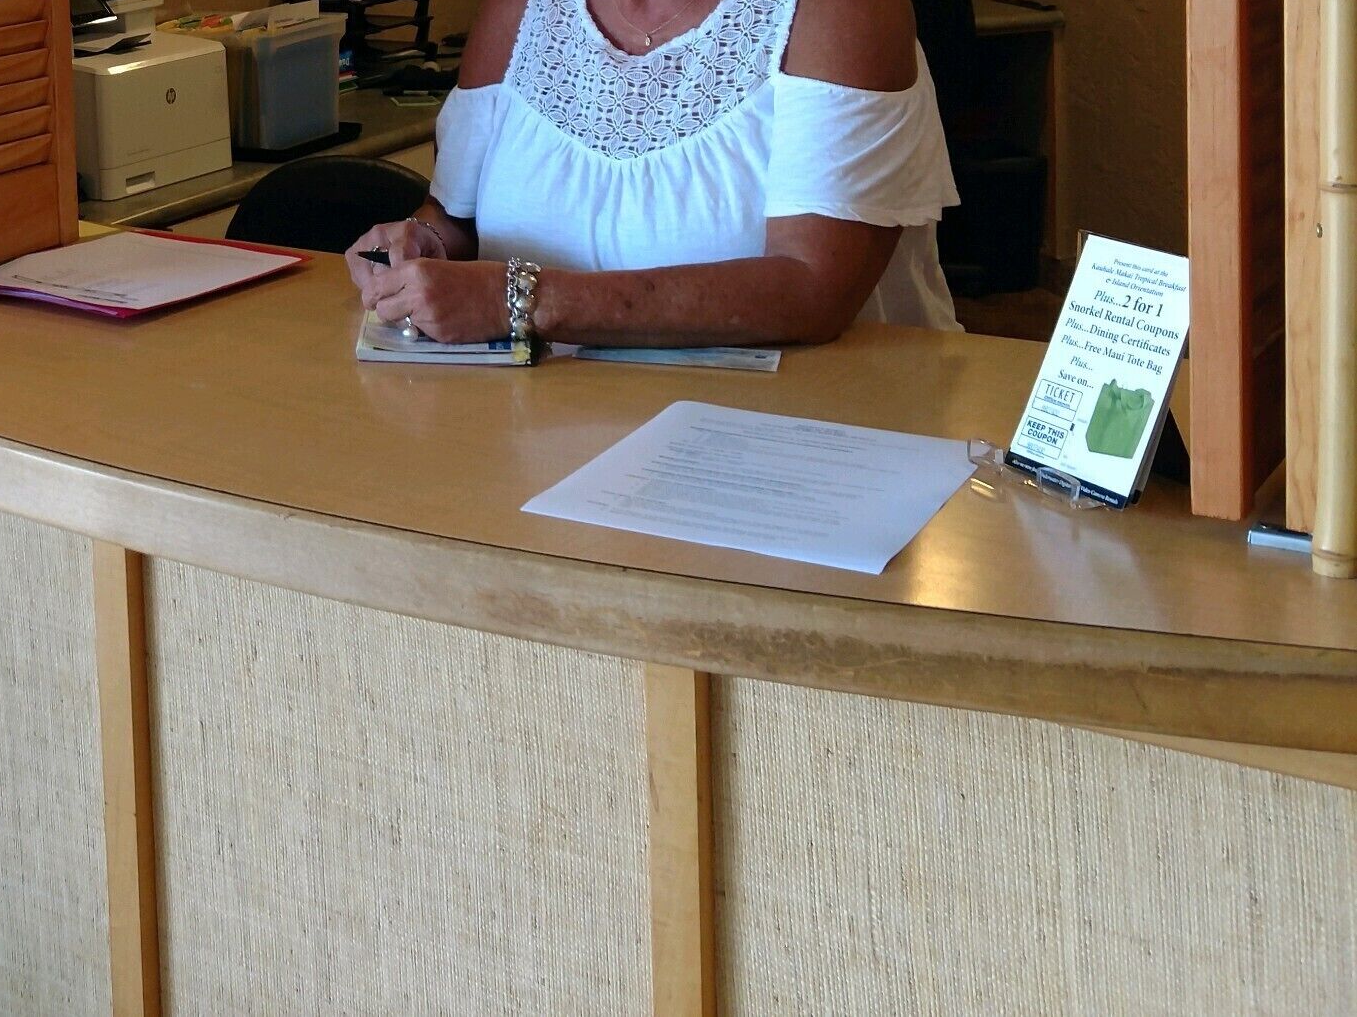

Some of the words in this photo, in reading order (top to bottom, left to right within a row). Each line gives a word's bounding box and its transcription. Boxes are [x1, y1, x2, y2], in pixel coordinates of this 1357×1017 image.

[1111, 278, 1130, 290] Island
[1130, 282, 1164, 298] Orientation
[1134, 273, 1159, 286] Tropical
[1158, 279, 1187, 293] Breakfast
[1133, 296, 1154, 315] for
[1155, 303, 1164, 318] 1
[1068, 300, 1105, 319] Snorkel
[1104, 309, 1136, 328] Rental
[1135, 319, 1180, 341] Coupons
[1120, 333, 1172, 357] Certificates
[1069, 355, 1094, 372] Plus...
[1102, 346, 1126, 362] Maui
[1126, 353, 1146, 368] Tote
[1145, 359, 1163, 376] Bag
[1057, 369, 1077, 384] Save
[1045, 383, 1076, 404] TICKET
[1026, 419, 1047, 432] KEEP
[1048, 426, 1065, 440] THIS
[1027, 428, 1059, 446] COUPON
